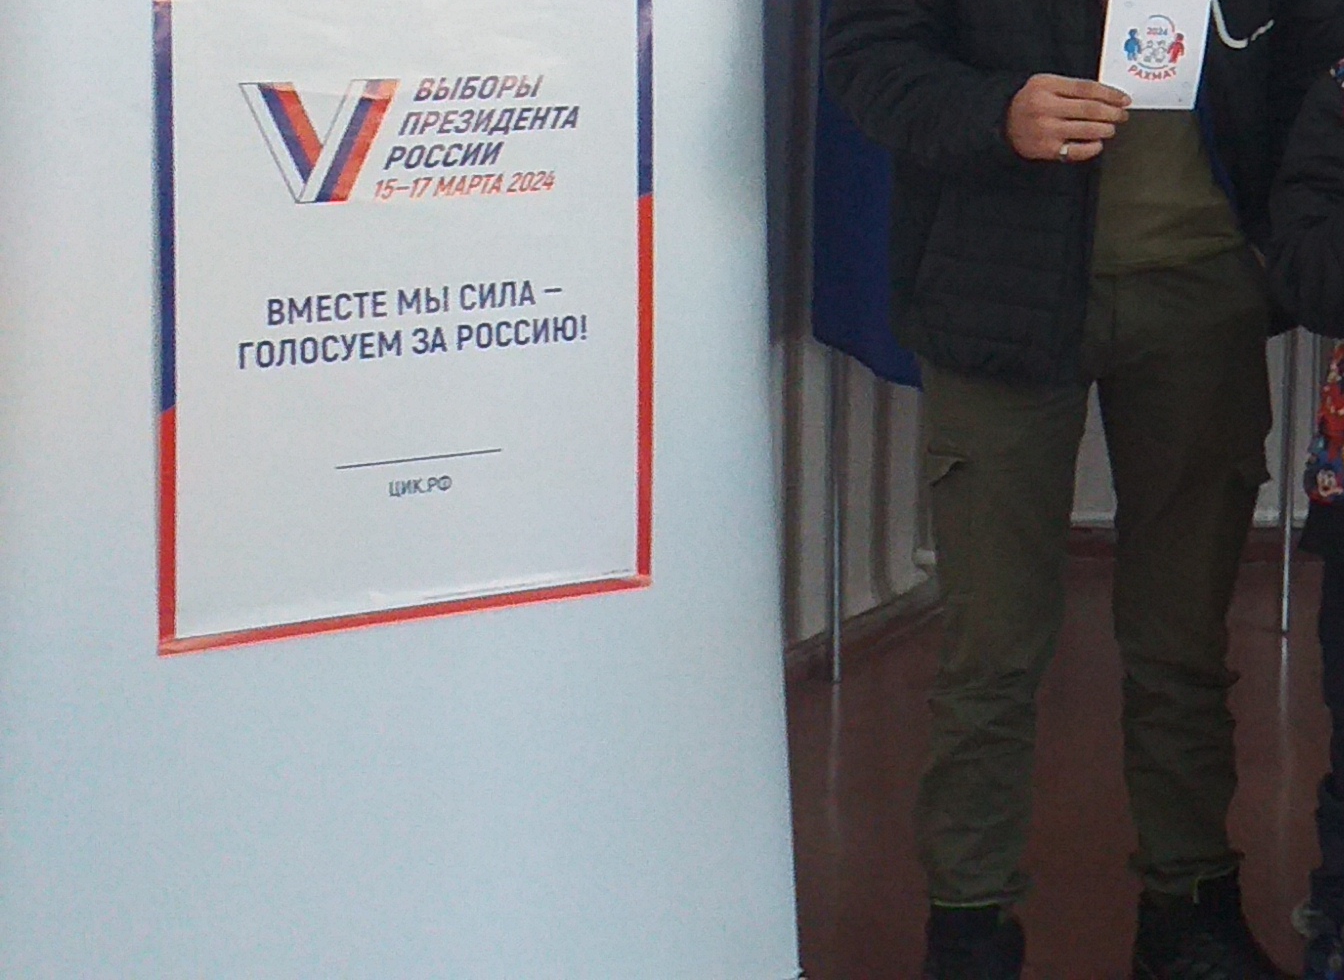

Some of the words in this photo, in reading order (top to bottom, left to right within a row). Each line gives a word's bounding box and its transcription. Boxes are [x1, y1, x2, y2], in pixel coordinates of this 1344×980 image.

[1128, 64, 1176, 80] РАХМАТ
[413, 74, 544, 102] ВЫБОРЫ
[398, 105, 580, 136] ПРЕЗИДЕНТА
[383, 141, 505, 170] РОССИИ
[433, 173, 504, 197] МАРТА
[506, 170, 556, 193] 2024
[266, 290, 388, 326] ВМЕСТЕ
[397, 285, 450, 316] МЫ
[460, 280, 536, 311] СИЛА
[237, 329, 403, 370] ГОЛОСУЕМ
[412, 326, 447, 355] ЗА
[456, 315, 588, 351] РОССИЮ!
[389, 475, 453, 497] ЦИК.РФ
